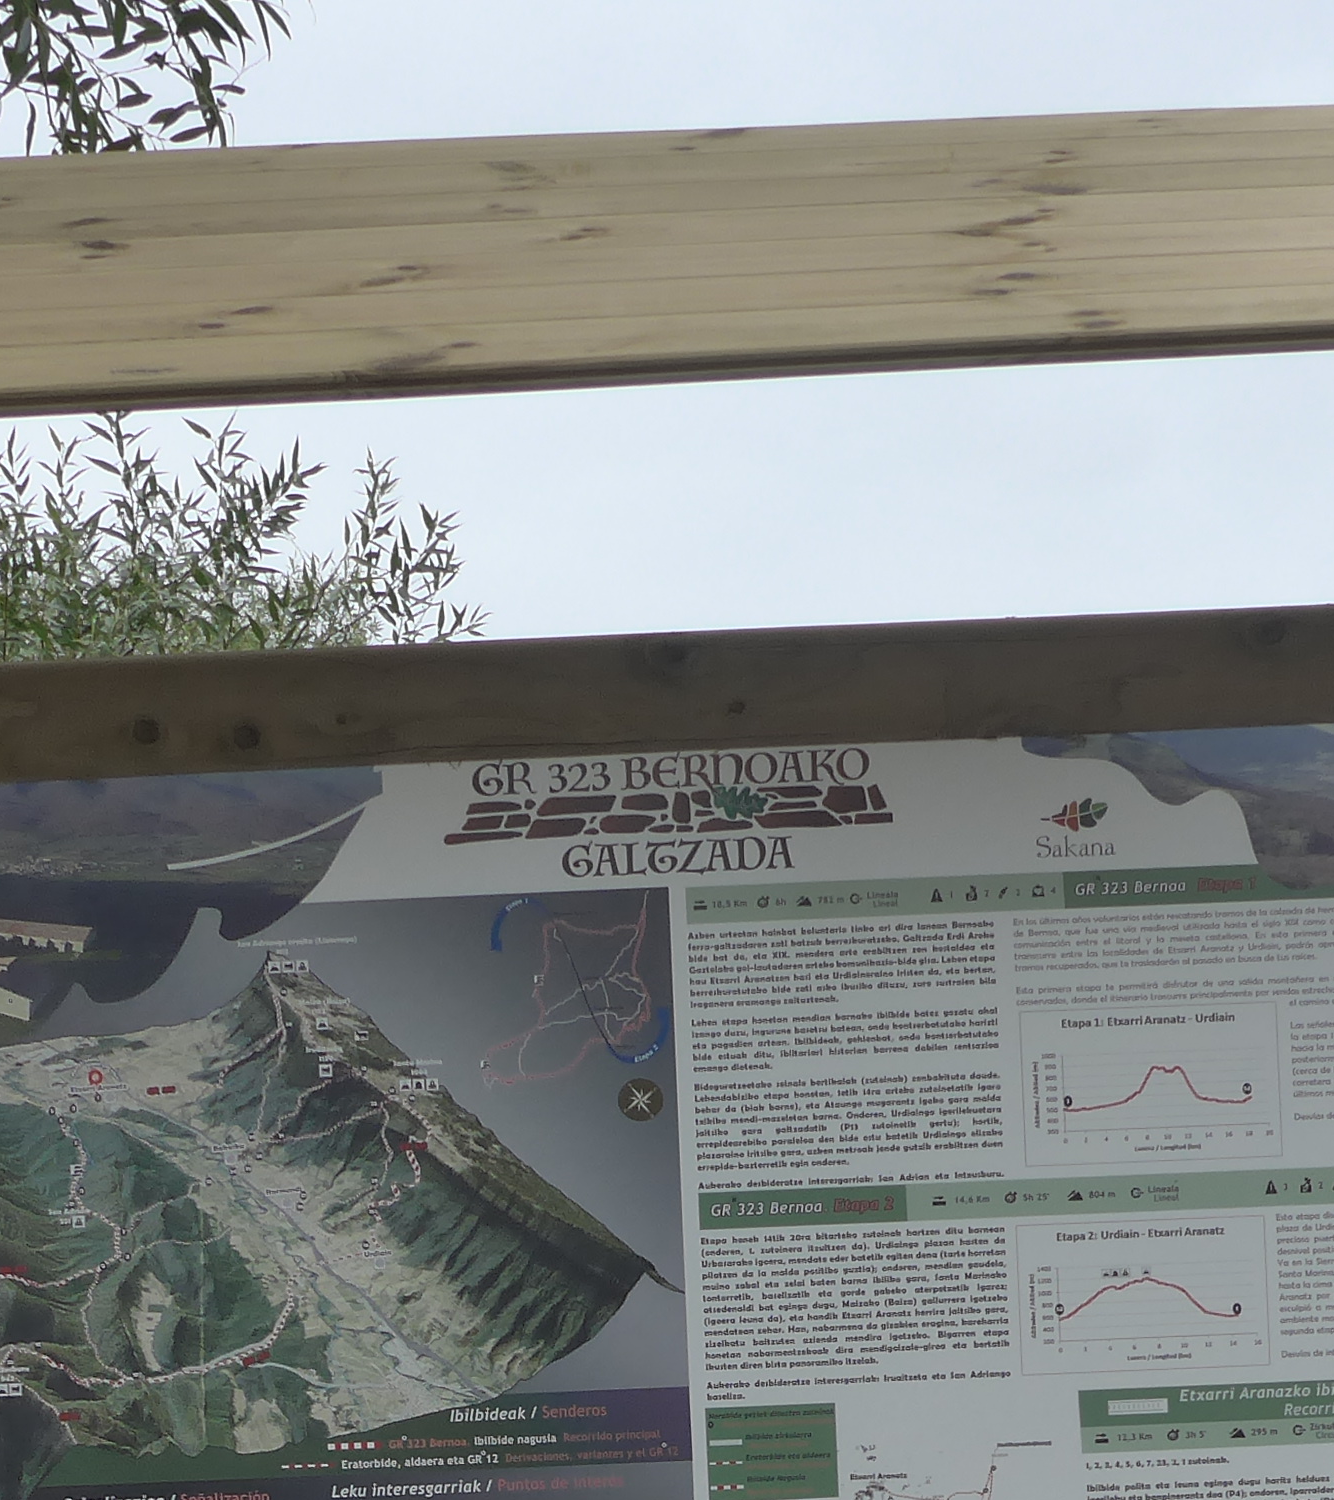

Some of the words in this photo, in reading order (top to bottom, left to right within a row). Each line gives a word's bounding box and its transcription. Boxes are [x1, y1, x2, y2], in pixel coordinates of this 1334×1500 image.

[472, 759, 535, 797] GR
[548, 761, 611, 794] 323
[621, 747, 869, 793] BERNOAKO
[1036, 834, 1115, 858] Sakana
[562, 836, 793, 878] GALTZADA
[1134, 880, 1186, 894] Bernoa
[1061, 1018, 1092, 1030] Etapa
[1107, 1015, 1143, 1027] Etxarri
[1144, 1014, 1186, 1025] Aranatz
[1195, 1012, 1235, 1023] Urdiain
[737, 1203, 764, 1216] 323
[834, 1198, 879, 1213] Etapa
[884, 1196, 894, 1210] 2
[1056, 1231, 1086, 1244] Etapa
[1101, 1229, 1140, 1240] Urdiain
[1148, 1227, 1182, 1238] Etxarri
[1184, 1226, 1225, 1237] Aranatz
[1179, 1387, 1235, 1402] Etxarri
[1239, 1384, 1311, 1399] Aranazko
[449, 1407, 526, 1423] Ibilbideak
[542, 1404, 607, 1419] Senderos
[341, 1458, 401, 1470] Eratorbide,
[404, 1456, 444, 1467] aldaera
[447, 1456, 464, 1465] eta
[331, 1484, 367, 1498] Leku
[372, 1479, 481, 1498] interesgarriak
[497, 1478, 546, 1493] Puntos
[551, 1477, 569, 1491] de
